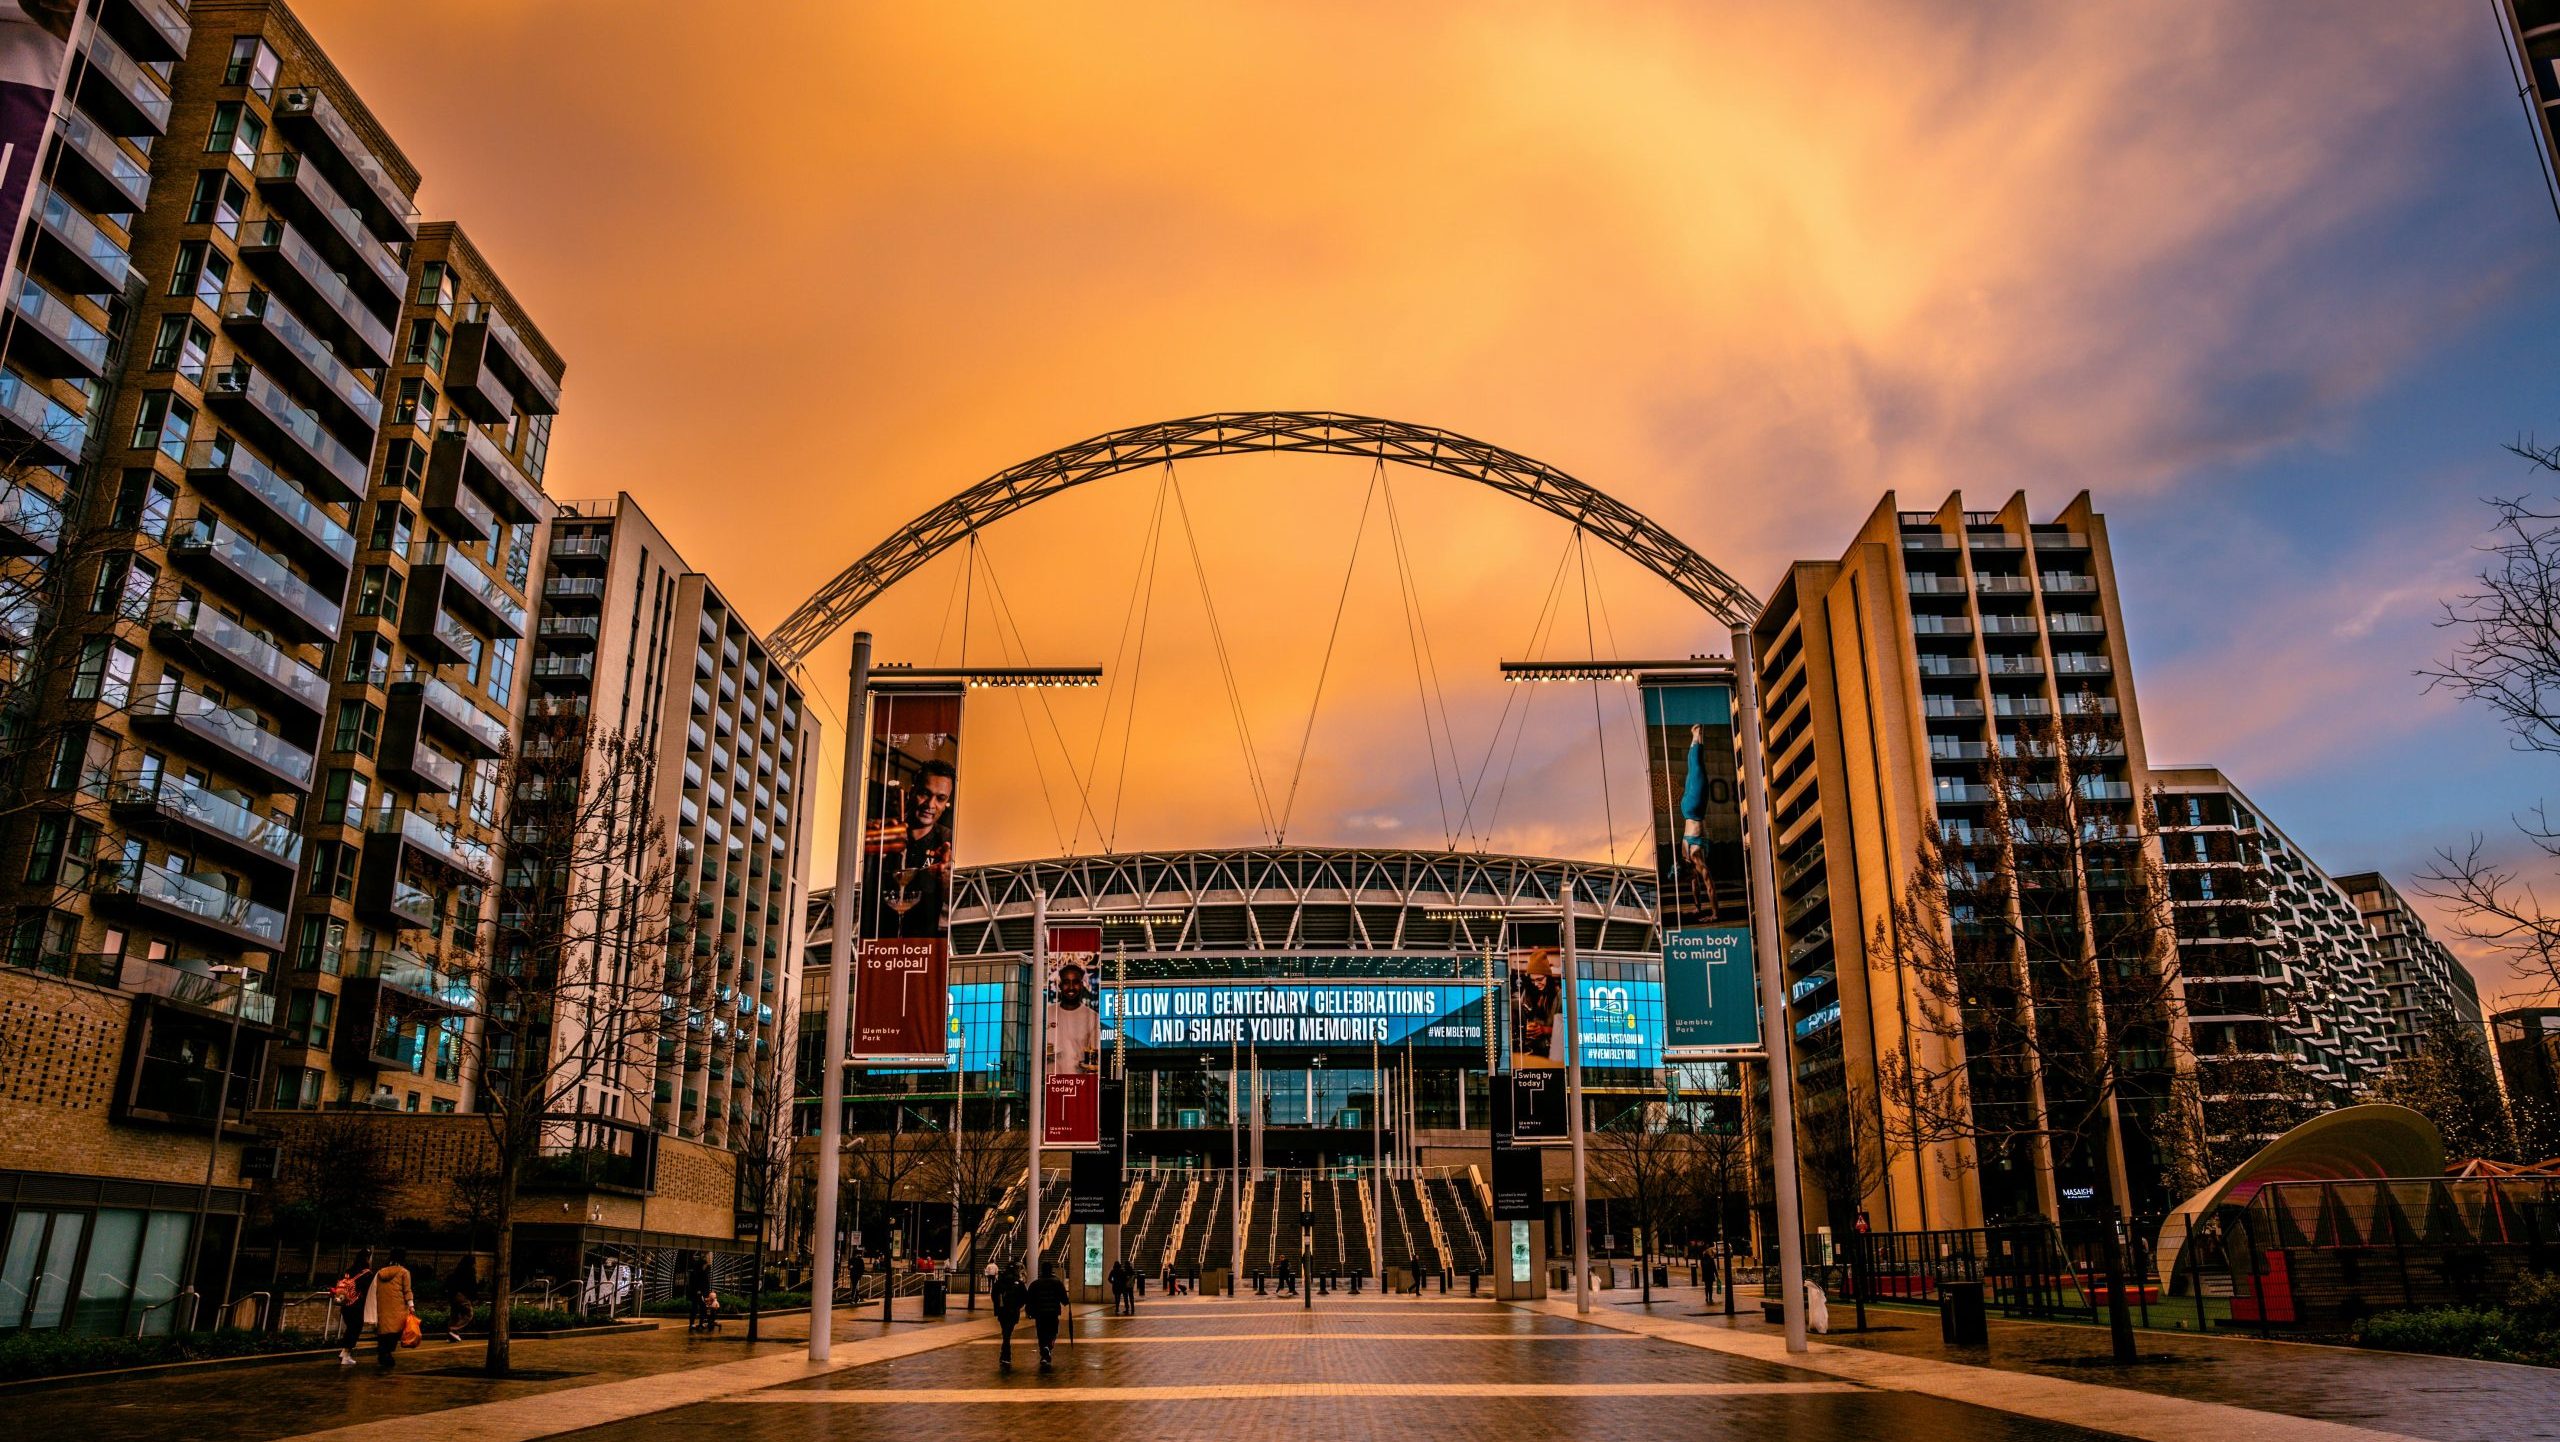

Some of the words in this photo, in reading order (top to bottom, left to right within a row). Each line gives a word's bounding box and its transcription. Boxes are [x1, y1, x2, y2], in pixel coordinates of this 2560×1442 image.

[1672, 936, 1702, 946] From
[1707, 934, 1738, 947] body
[868, 944, 898, 955] From
[902, 944, 932, 954] local
[1672, 950, 1686, 960] to
[1691, 948, 1720, 959] mind
[867, 959, 881, 968] to
[885, 958, 922, 970] global
[1105, 992, 1170, 1016] FOLLOW
[1174, 992, 1207, 1016] OUR
[1213, 990, 1309, 1015] CENTENARY
[1314, 990, 1435, 1014] CELEBRATIONS
[1150, 1019, 1184, 1042] AND
[1190, 1018, 1244, 1042] SHARE
[1250, 1018, 1295, 1041] YOUR
[1299, 1017, 1388, 1041] MEMORIES
[1428, 1026, 1480, 1038] #WEMBLEY100
[1588, 1048, 1636, 1060] #WEMBLEY100
[1052, 1078, 1074, 1086] Swing
[1076, 1078, 1085, 1086] by
[1052, 1086, 1073, 1094] today
[583, 1264, 631, 1304] AMP
